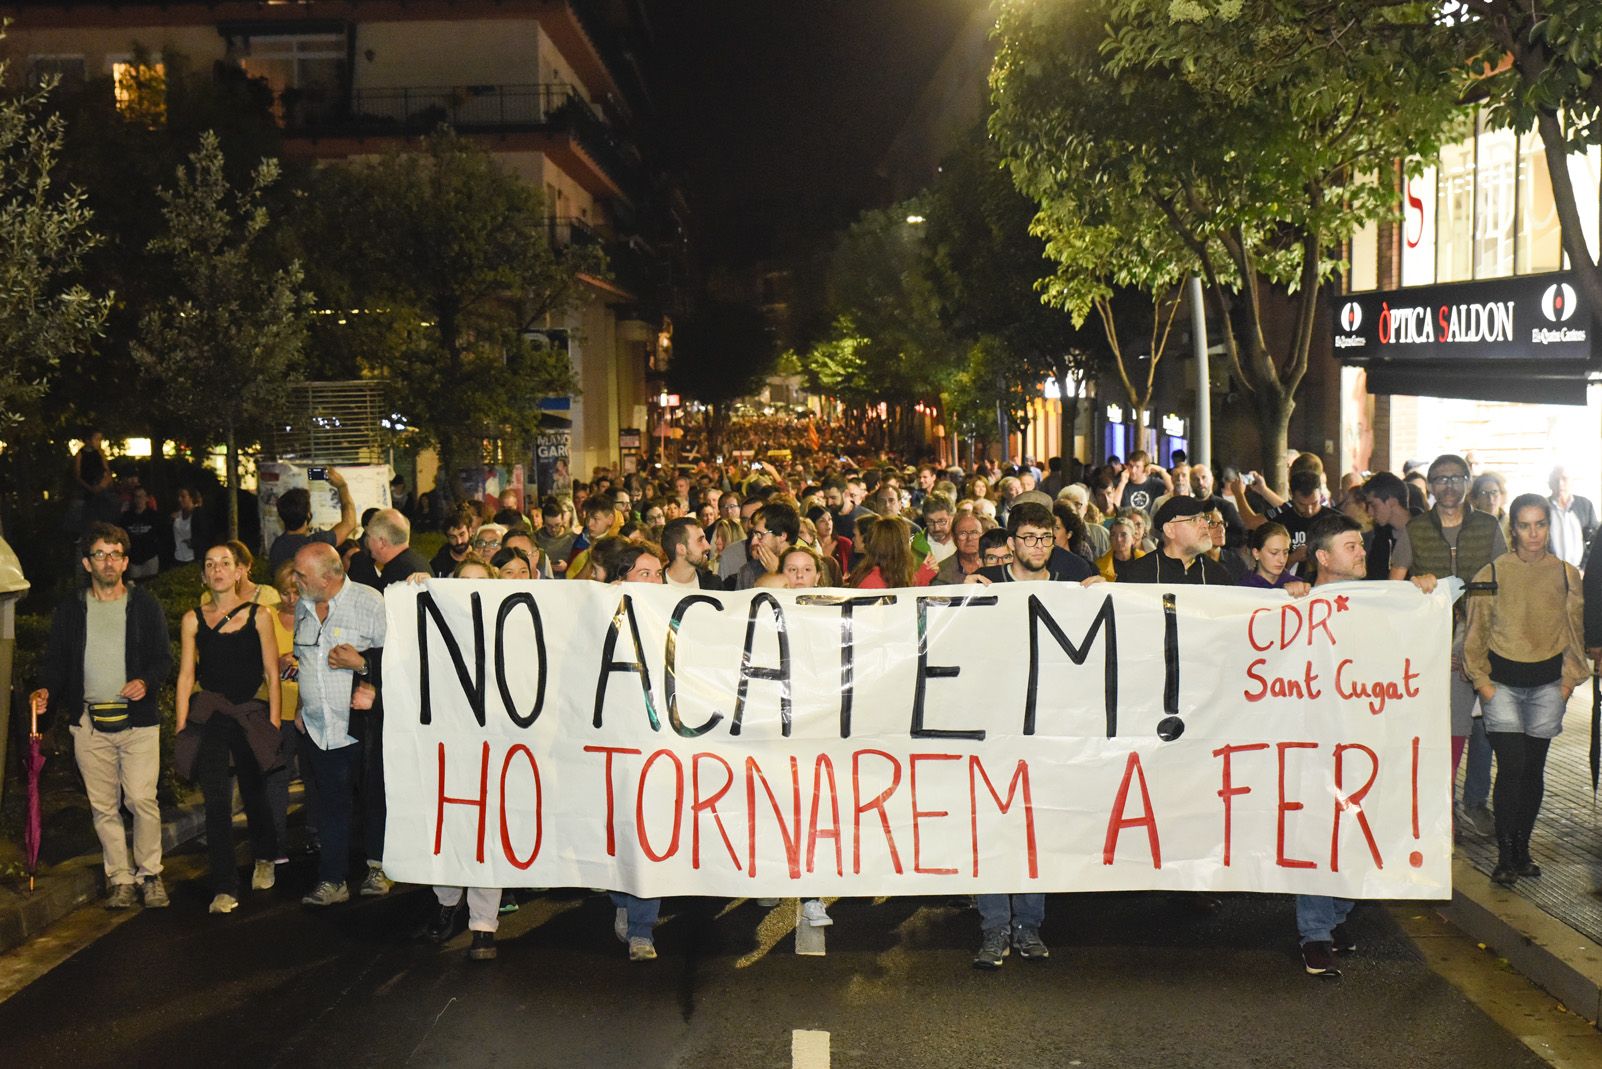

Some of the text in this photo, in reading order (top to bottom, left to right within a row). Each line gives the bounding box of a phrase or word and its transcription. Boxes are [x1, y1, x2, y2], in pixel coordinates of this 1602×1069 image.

[1378, 301, 1515, 344] ÒPTICA SALDON
[417, 591, 1184, 741] NO ACATEM!
[1244, 658, 1420, 714] Sant Cugat
[433, 737, 1423, 880] HO TORNAREM A FER!
